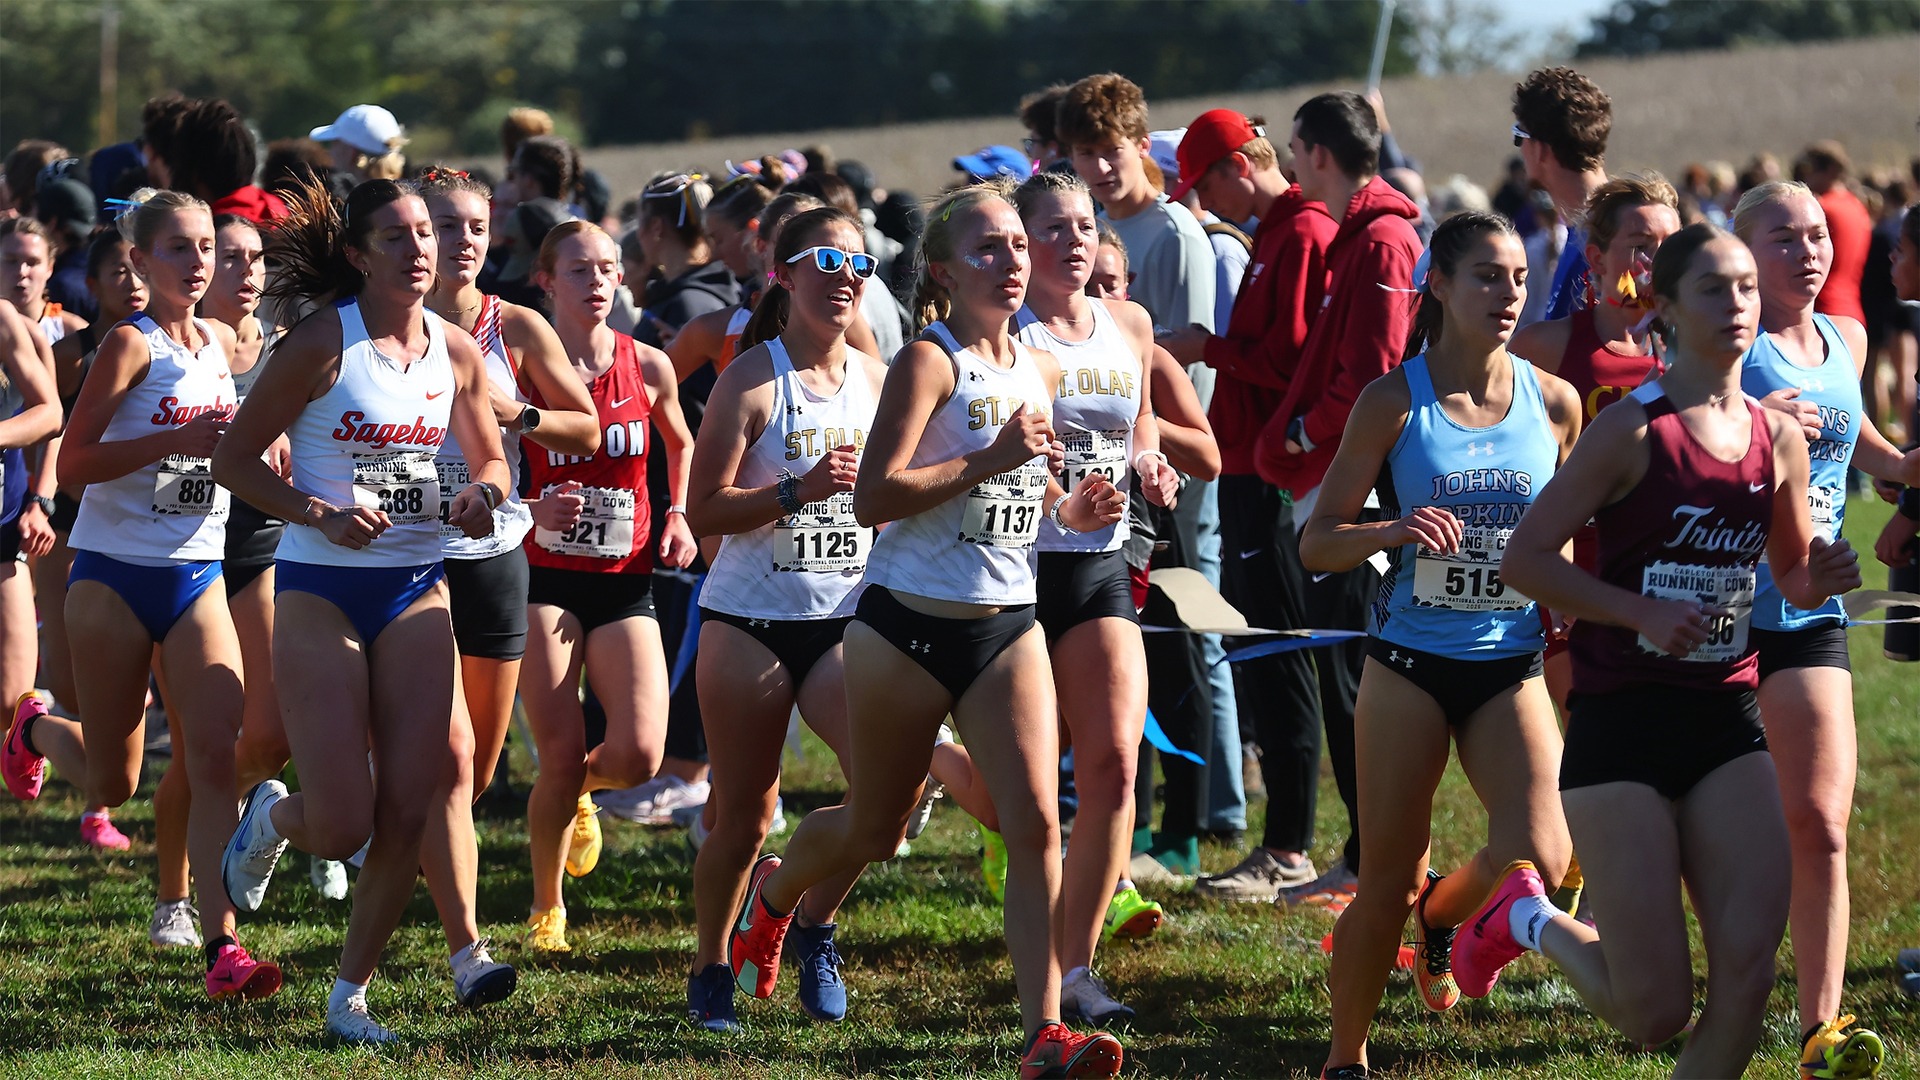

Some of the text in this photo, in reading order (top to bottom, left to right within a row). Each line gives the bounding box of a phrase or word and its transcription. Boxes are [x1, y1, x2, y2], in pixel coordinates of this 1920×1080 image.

[1058, 368, 1134, 399] T. OLAF
[968, 396, 1006, 431] ST.
[785, 428, 869, 461] ST. OLA
[1064, 440, 1093, 452] NING
[1101, 438, 1124, 450] COWS
[355, 461, 408, 472] RUNNING
[179, 479, 215, 504] 887
[1030, 475, 1048, 488] COWS
[1431, 468, 1532, 500] JOHNS
[378, 488, 423, 515] 888
[603, 498, 633, 509] COWS
[800, 503, 828, 515] NING
[986, 504, 1035, 534] 1137
[561, 521, 606, 545] 921
[794, 532, 857, 558] 1125
[1664, 505, 1767, 565] Trinity
[1445, 567, 1505, 598] 515
[1647, 572, 1715, 593] RUNNING
[1725, 577, 1754, 592] COWS
[1674, 568, 1715, 578] CARLETON
[1435, 595, 1475, 603] PRE-NATIONAL
